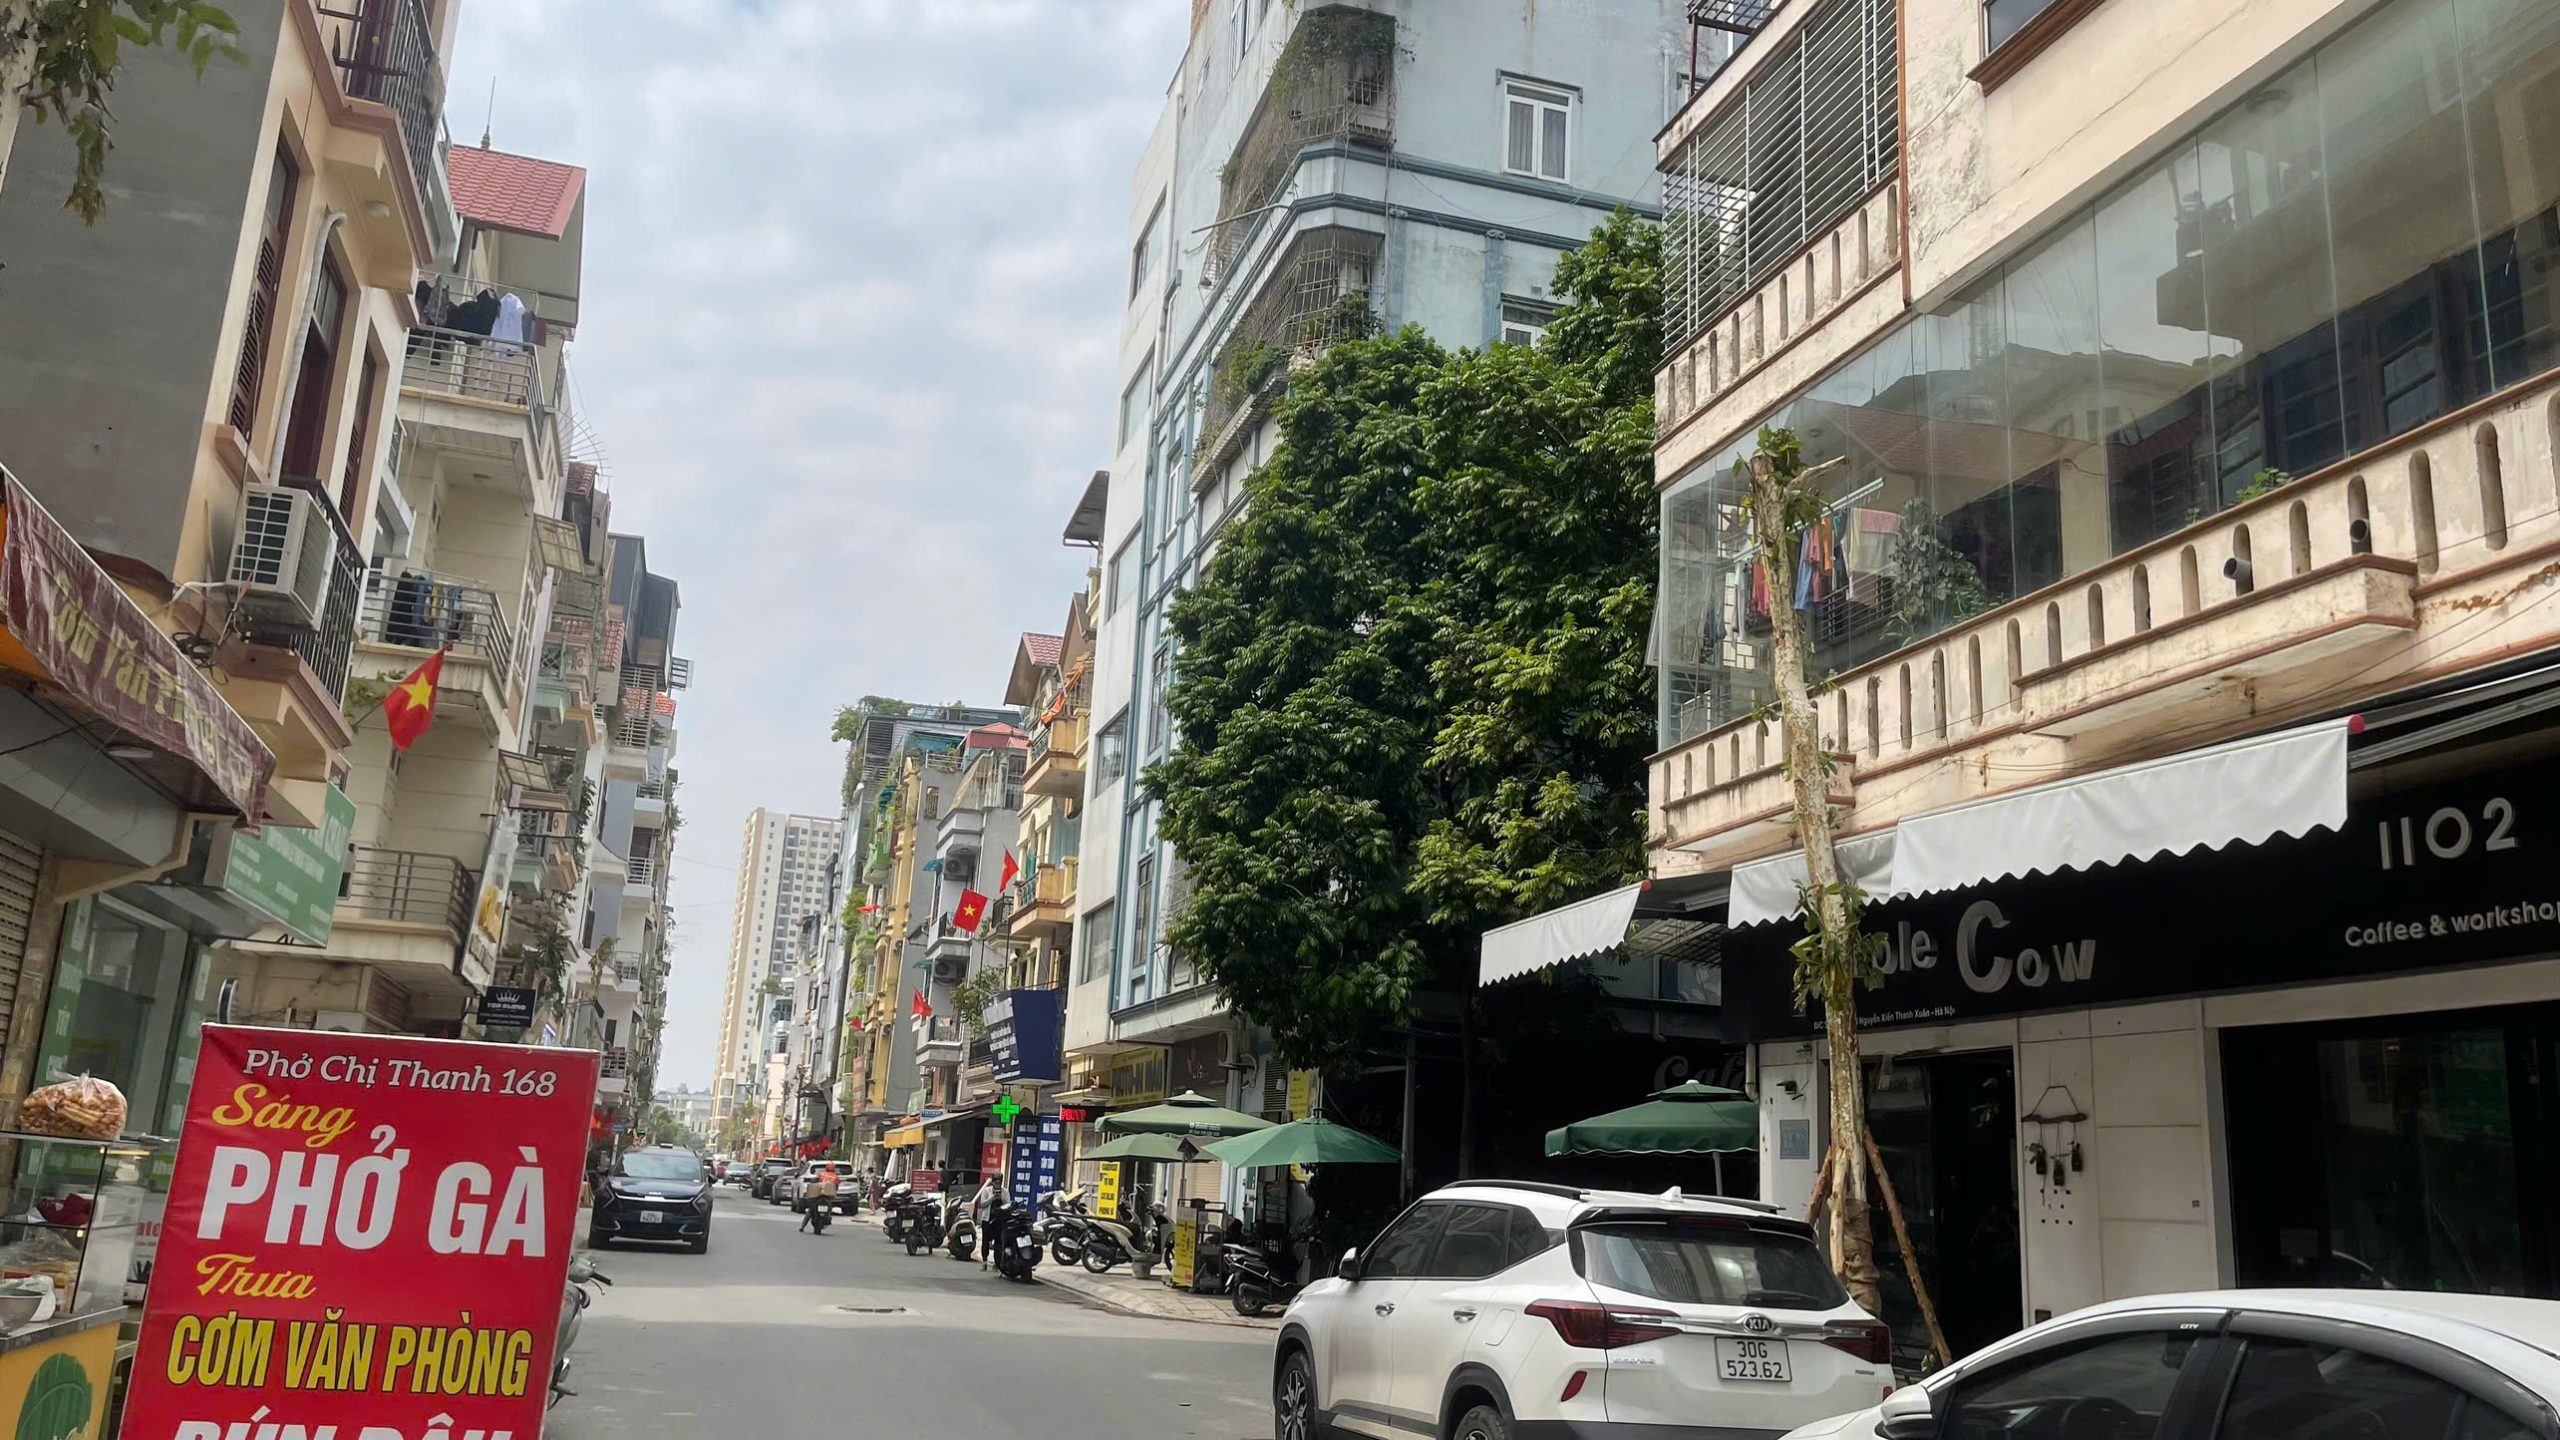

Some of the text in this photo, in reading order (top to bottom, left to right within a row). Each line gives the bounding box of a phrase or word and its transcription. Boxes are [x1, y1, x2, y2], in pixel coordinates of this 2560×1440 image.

[1956, 900, 2097, 993] Cow
[2345, 900, 2560, 947] Coffee & worksho
[1895, 1010, 1914, 1021] Thanh
[243, 1049, 557, 1097] Phở Chị Thanh 168
[210, 1083, 357, 1148] Sáng
[196, 1124, 547, 1258] PHỞ GÀ
[196, 1253, 317, 1299] Trưa
[1749, 1318, 1770, 1330] KIA
[166, 1307, 533, 1397] CƠM VĂN PHÒNG
[1727, 1360, 1783, 1379] 523.62
[1737, 1341, 1767, 1358] 30G
